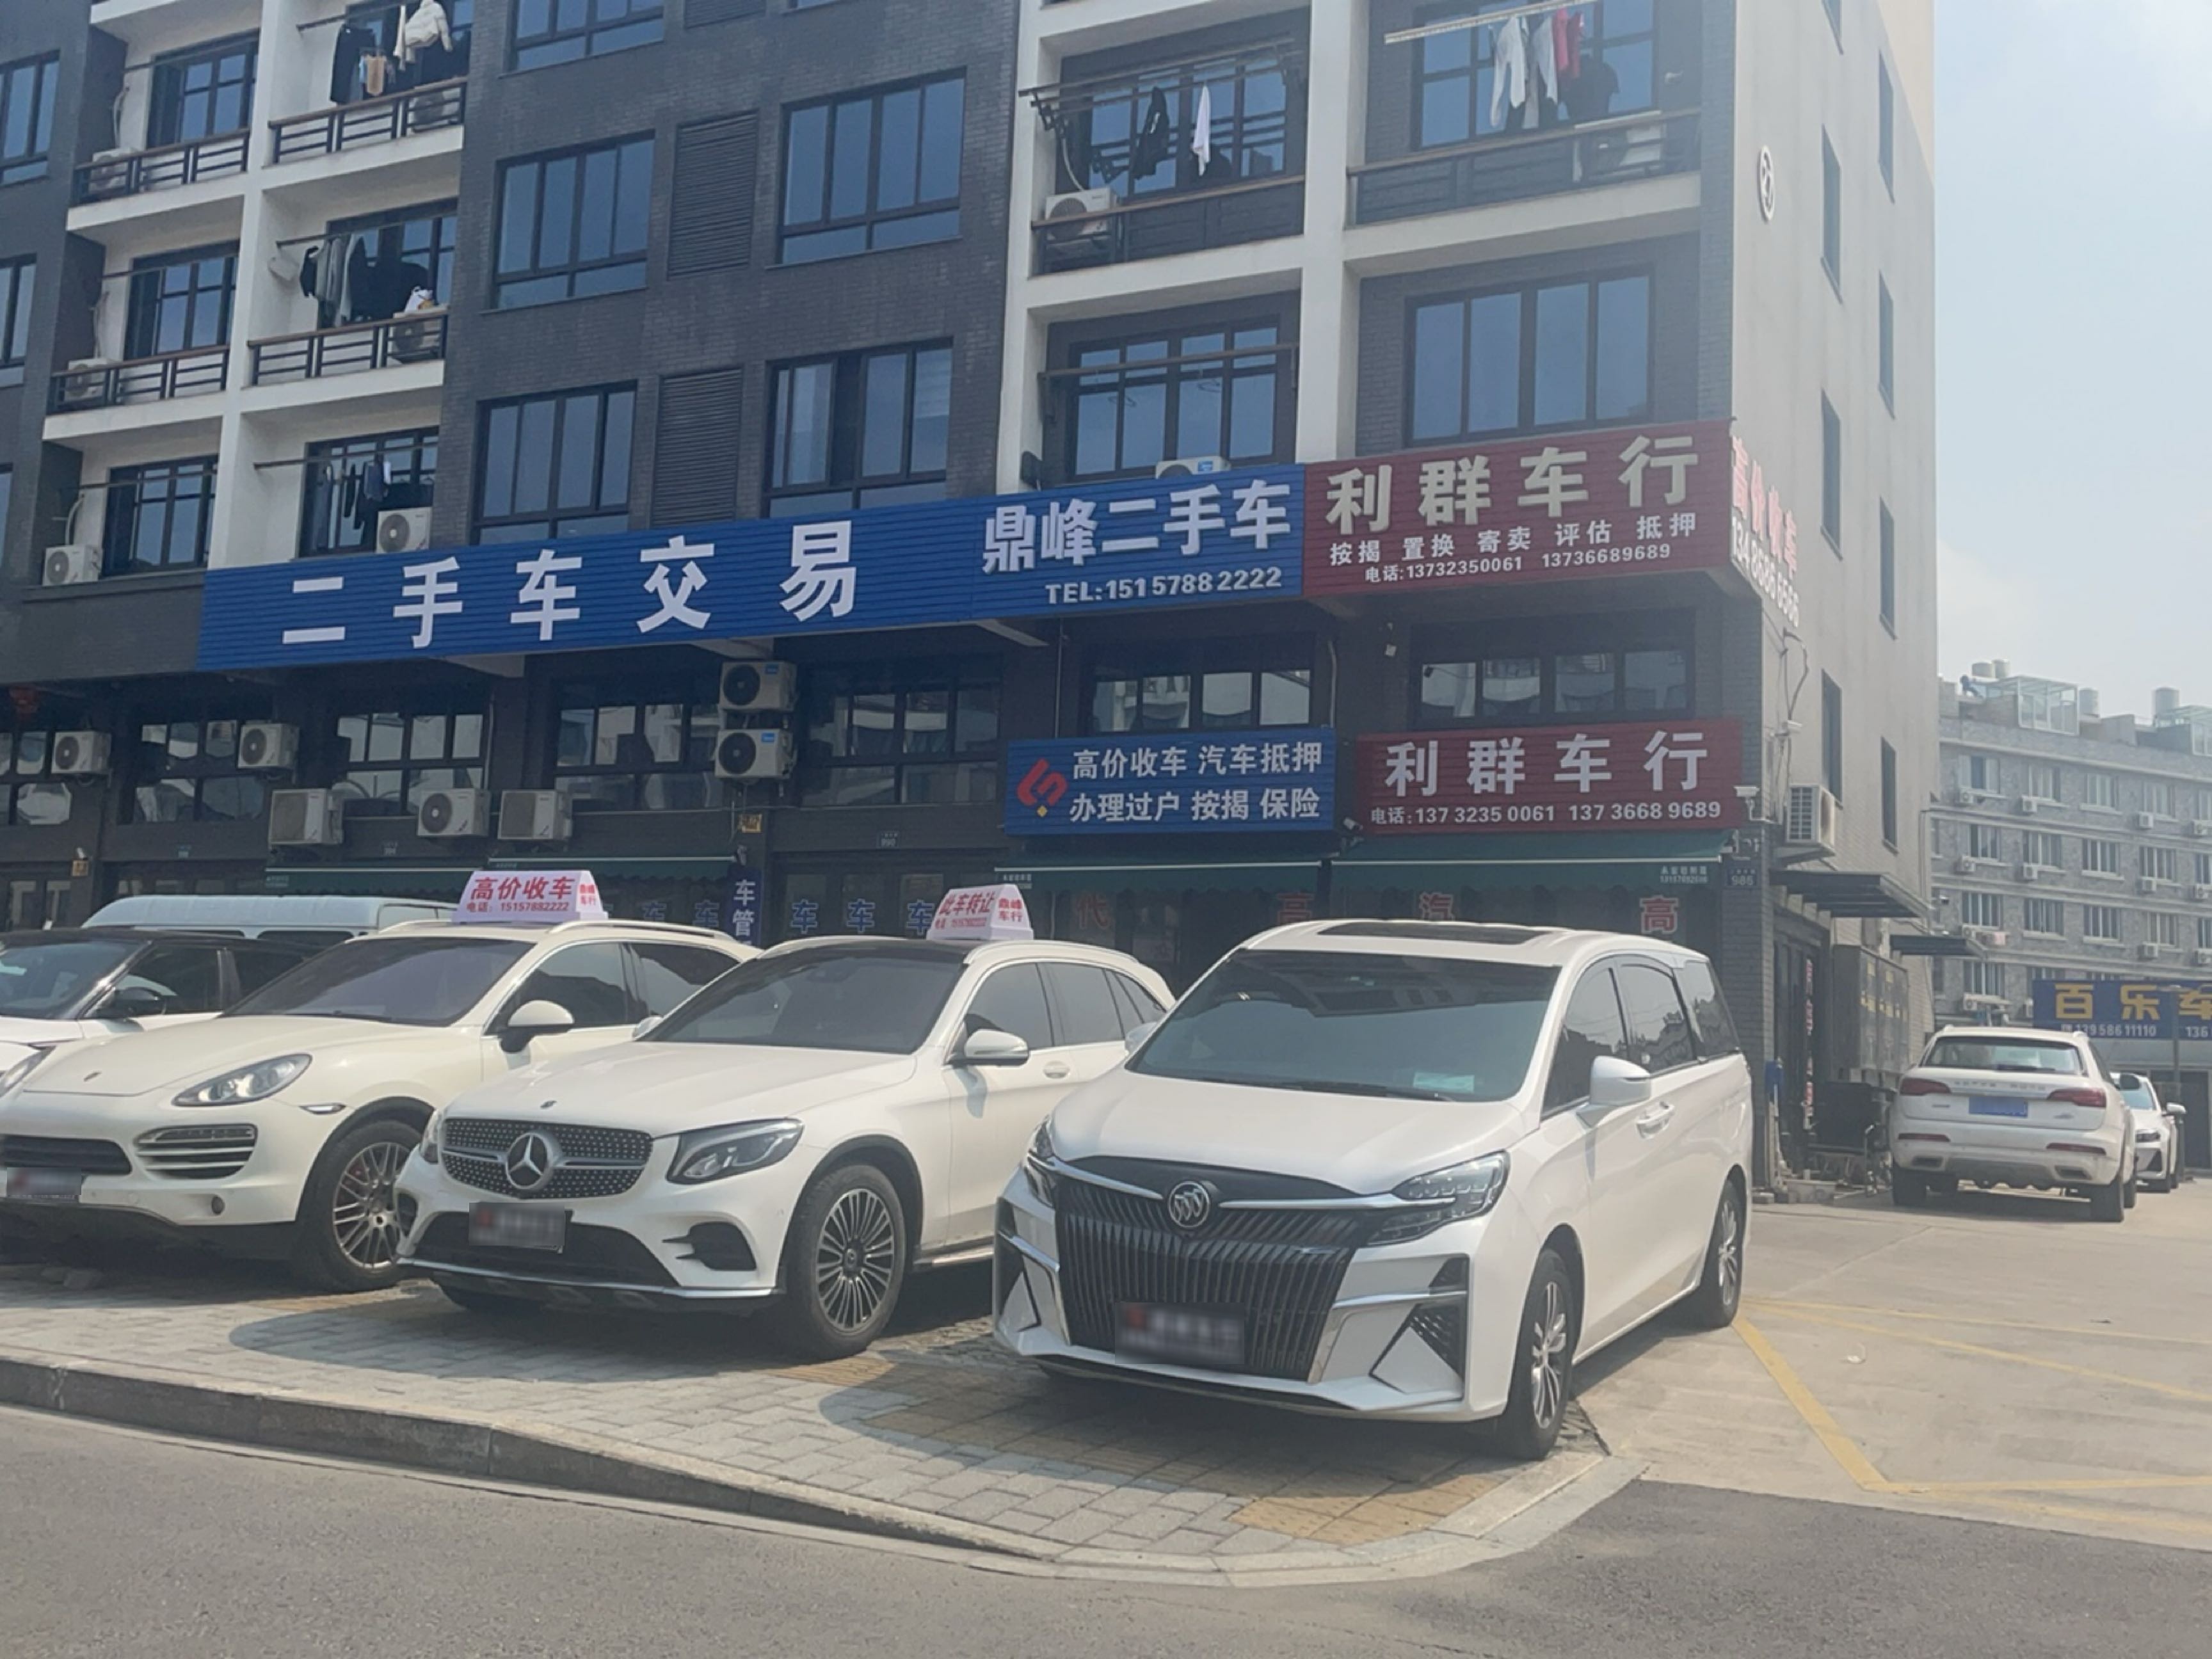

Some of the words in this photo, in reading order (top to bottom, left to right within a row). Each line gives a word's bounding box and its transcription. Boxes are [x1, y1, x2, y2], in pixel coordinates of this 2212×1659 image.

[1326, 435, 1699, 534] 利群车行
[982, 479, 1291, 574] 鼎峰二手车
[1330, 541, 1381, 566] 按揭
[1402, 533, 1455, 561] 置换
[1477, 526, 1532, 553] 寄卖
[1555, 518, 1612, 548] 评估
[1636, 513, 1697, 540] 抵押
[1542, 543, 1670, 568] 13736689689
[282, 520, 856, 648] 二手车交易
[1073, 747, 1187, 780] 高价收车
[1198, 742, 1322, 774] 汽车抵押
[1385, 730, 1707, 797] 利群车行
[1070, 791, 1180, 822] 办理过户
[1192, 789, 1249, 821] 按揭
[1260, 788, 1320, 819] 保险
[470, 876, 575, 900] 高价收车
[732, 879, 756, 945] 车管
[790, 898, 819, 934] 车
[847, 898, 875, 934] 车
[1640, 895, 1679, 934] 高
